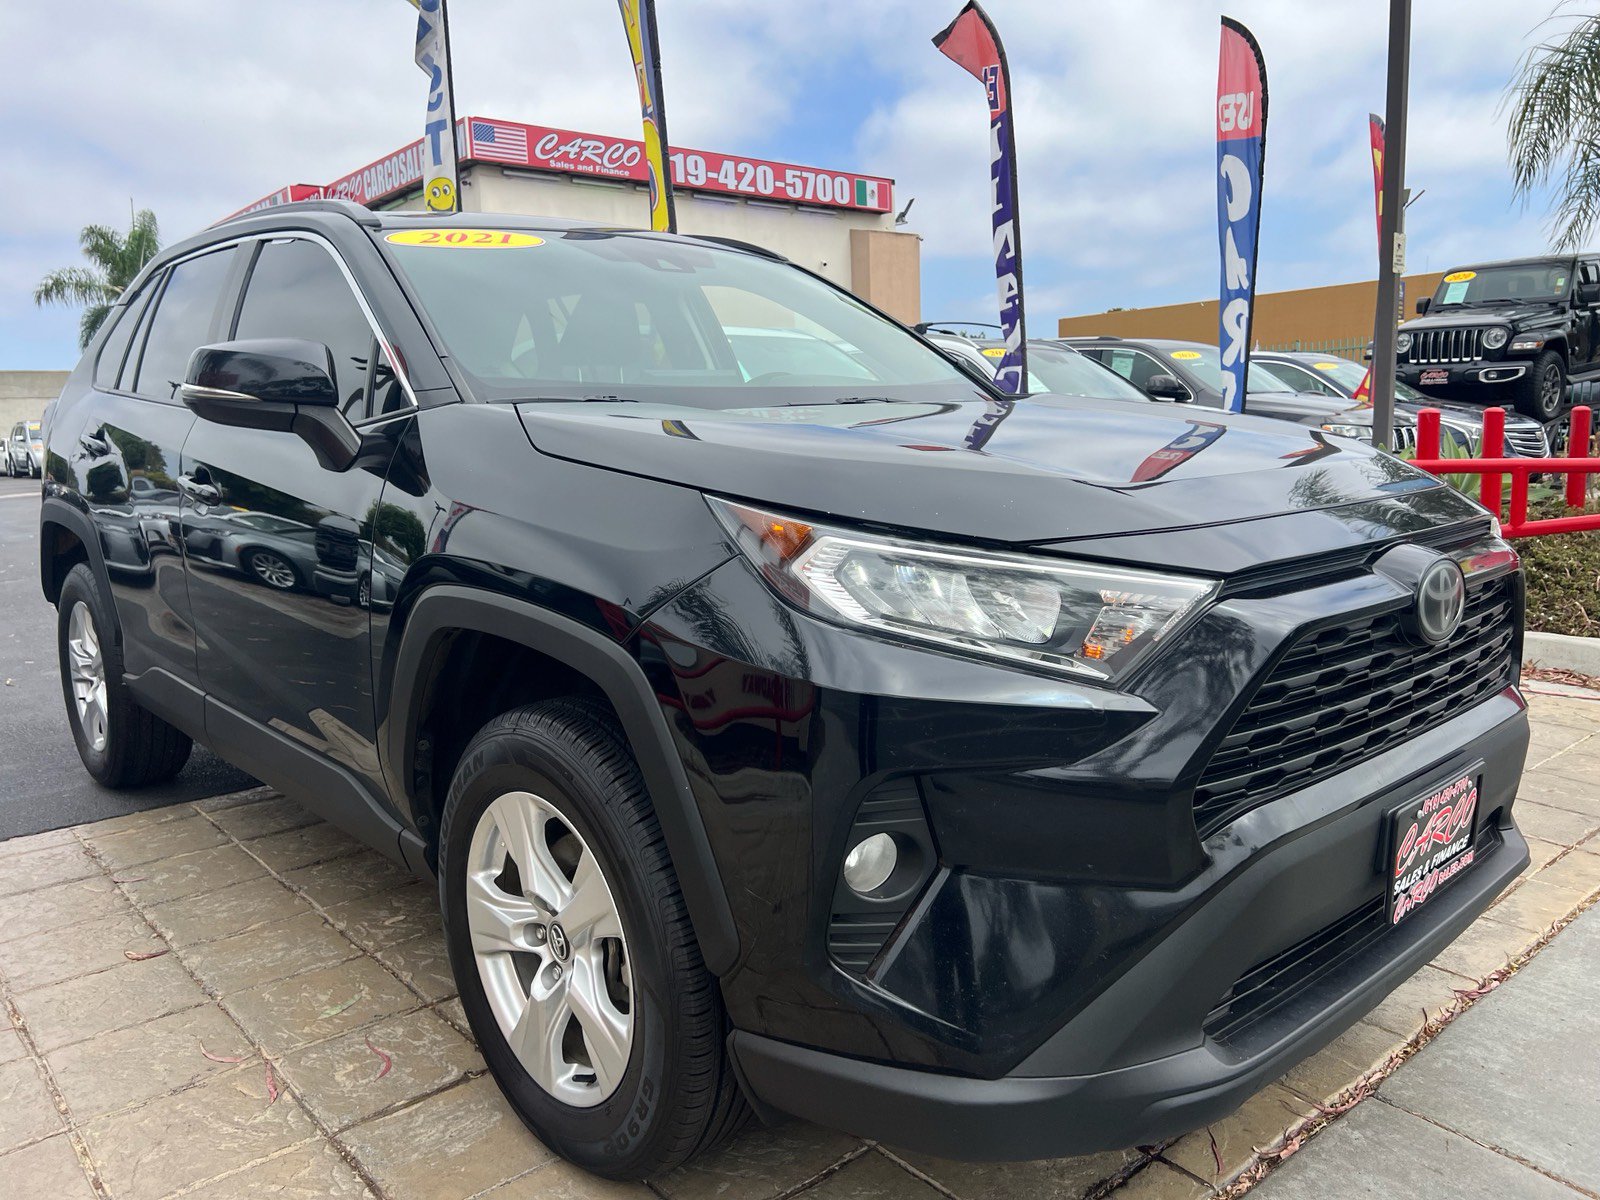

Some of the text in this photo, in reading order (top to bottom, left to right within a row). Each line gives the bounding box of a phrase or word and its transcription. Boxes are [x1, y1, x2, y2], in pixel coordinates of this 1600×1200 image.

[534, 133, 850, 205] CARCO 19-420-5700
[549, 160, 630, 177] Sales and Finance
[419, 231, 513, 245] 2021
[1395, 787, 1478, 878] CARCO
[1394, 834, 1470, 896] SALES & FINANCE
